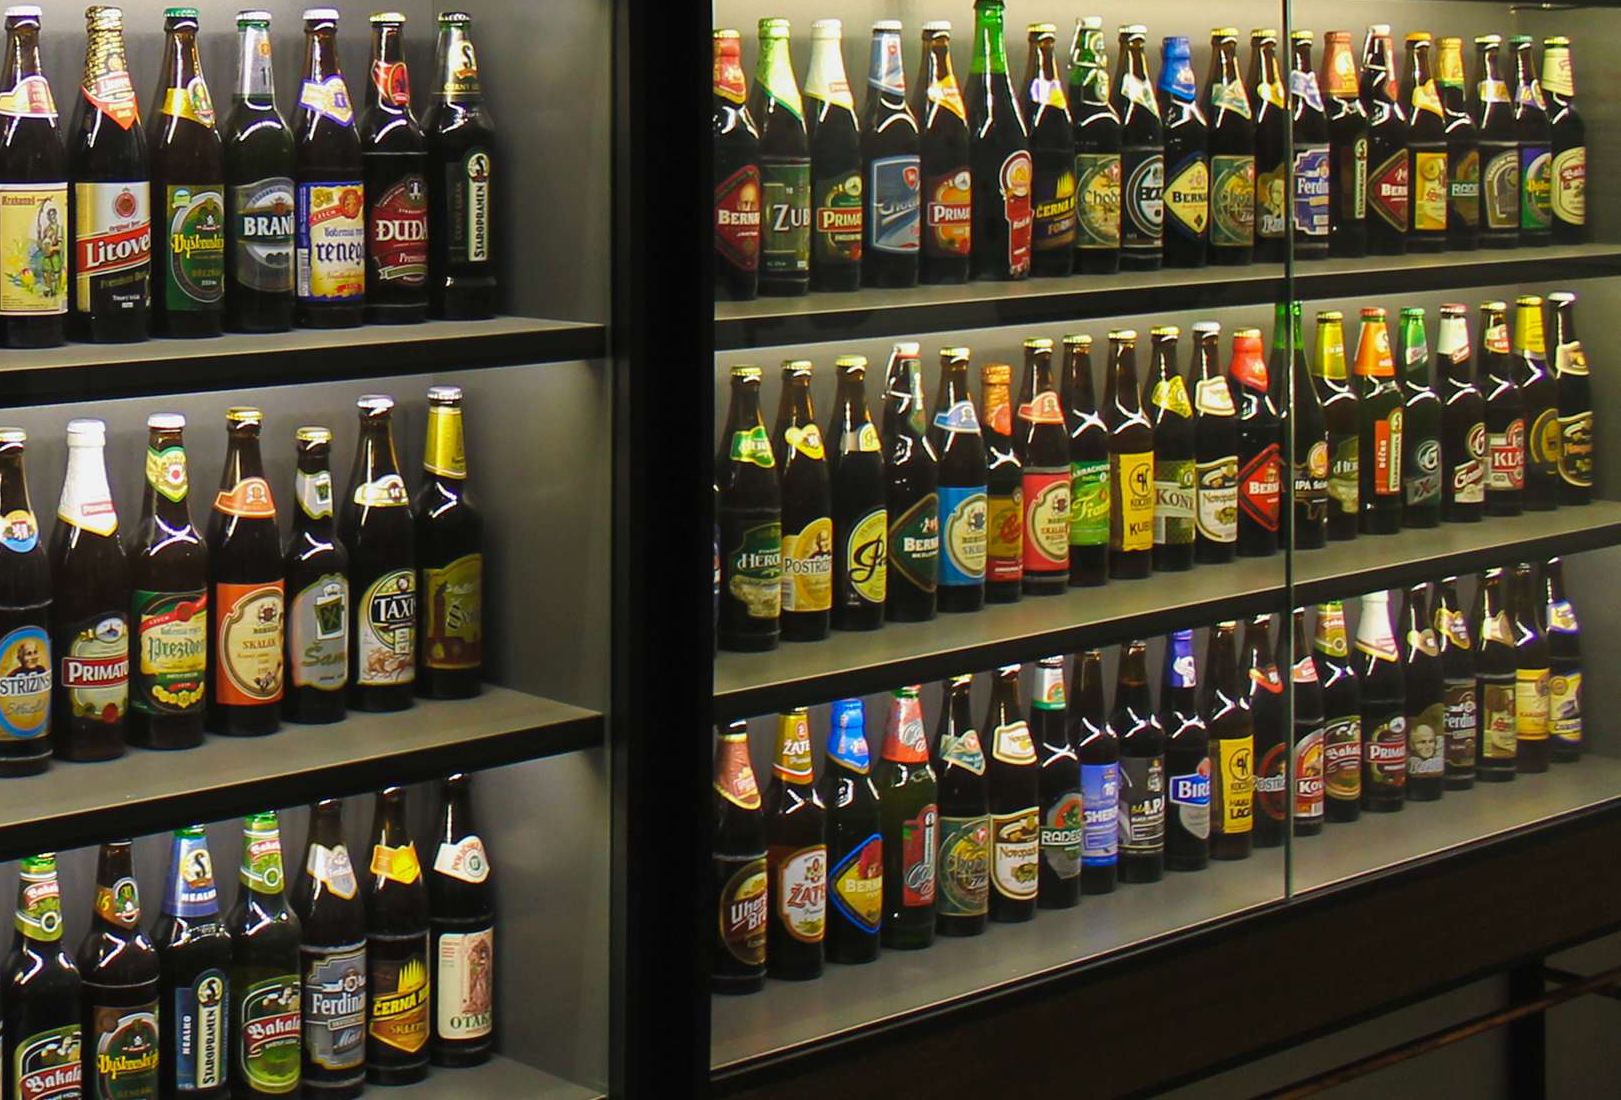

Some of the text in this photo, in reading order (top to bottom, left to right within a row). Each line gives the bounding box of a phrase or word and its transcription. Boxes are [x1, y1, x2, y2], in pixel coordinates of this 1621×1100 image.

[473, 179, 487, 258] STAROPRAMEN
[373, 992, 417, 1017] ČERNÁ
[202, 1007, 217, 1086] STAROPRAMEN
